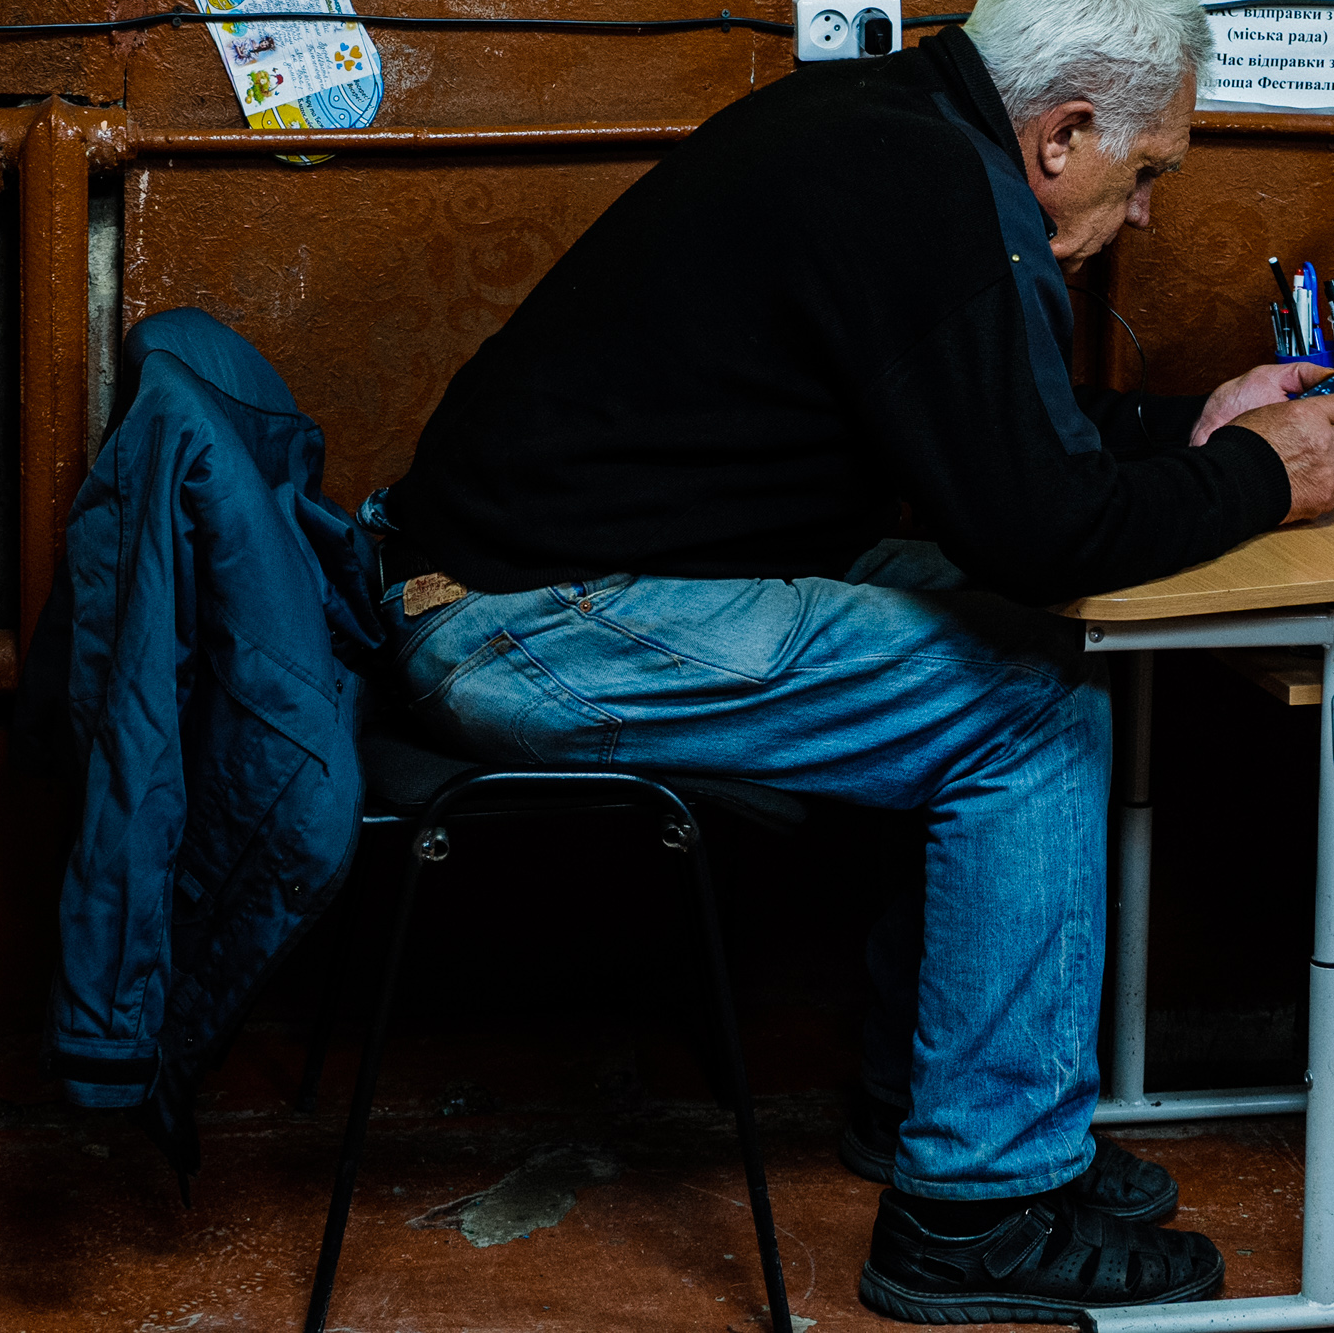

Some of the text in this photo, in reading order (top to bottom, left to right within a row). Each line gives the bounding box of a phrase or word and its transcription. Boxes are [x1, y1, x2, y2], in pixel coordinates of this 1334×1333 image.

[1244, 8, 1322, 22] відправки
[1326, 11, 1333, 20] з
[1227, 27, 1283, 42] (міська
[1288, 30, 1328, 44] рада)
[1216, 53, 1244, 66] Час
[1248, 55, 1325, 70] відправки
